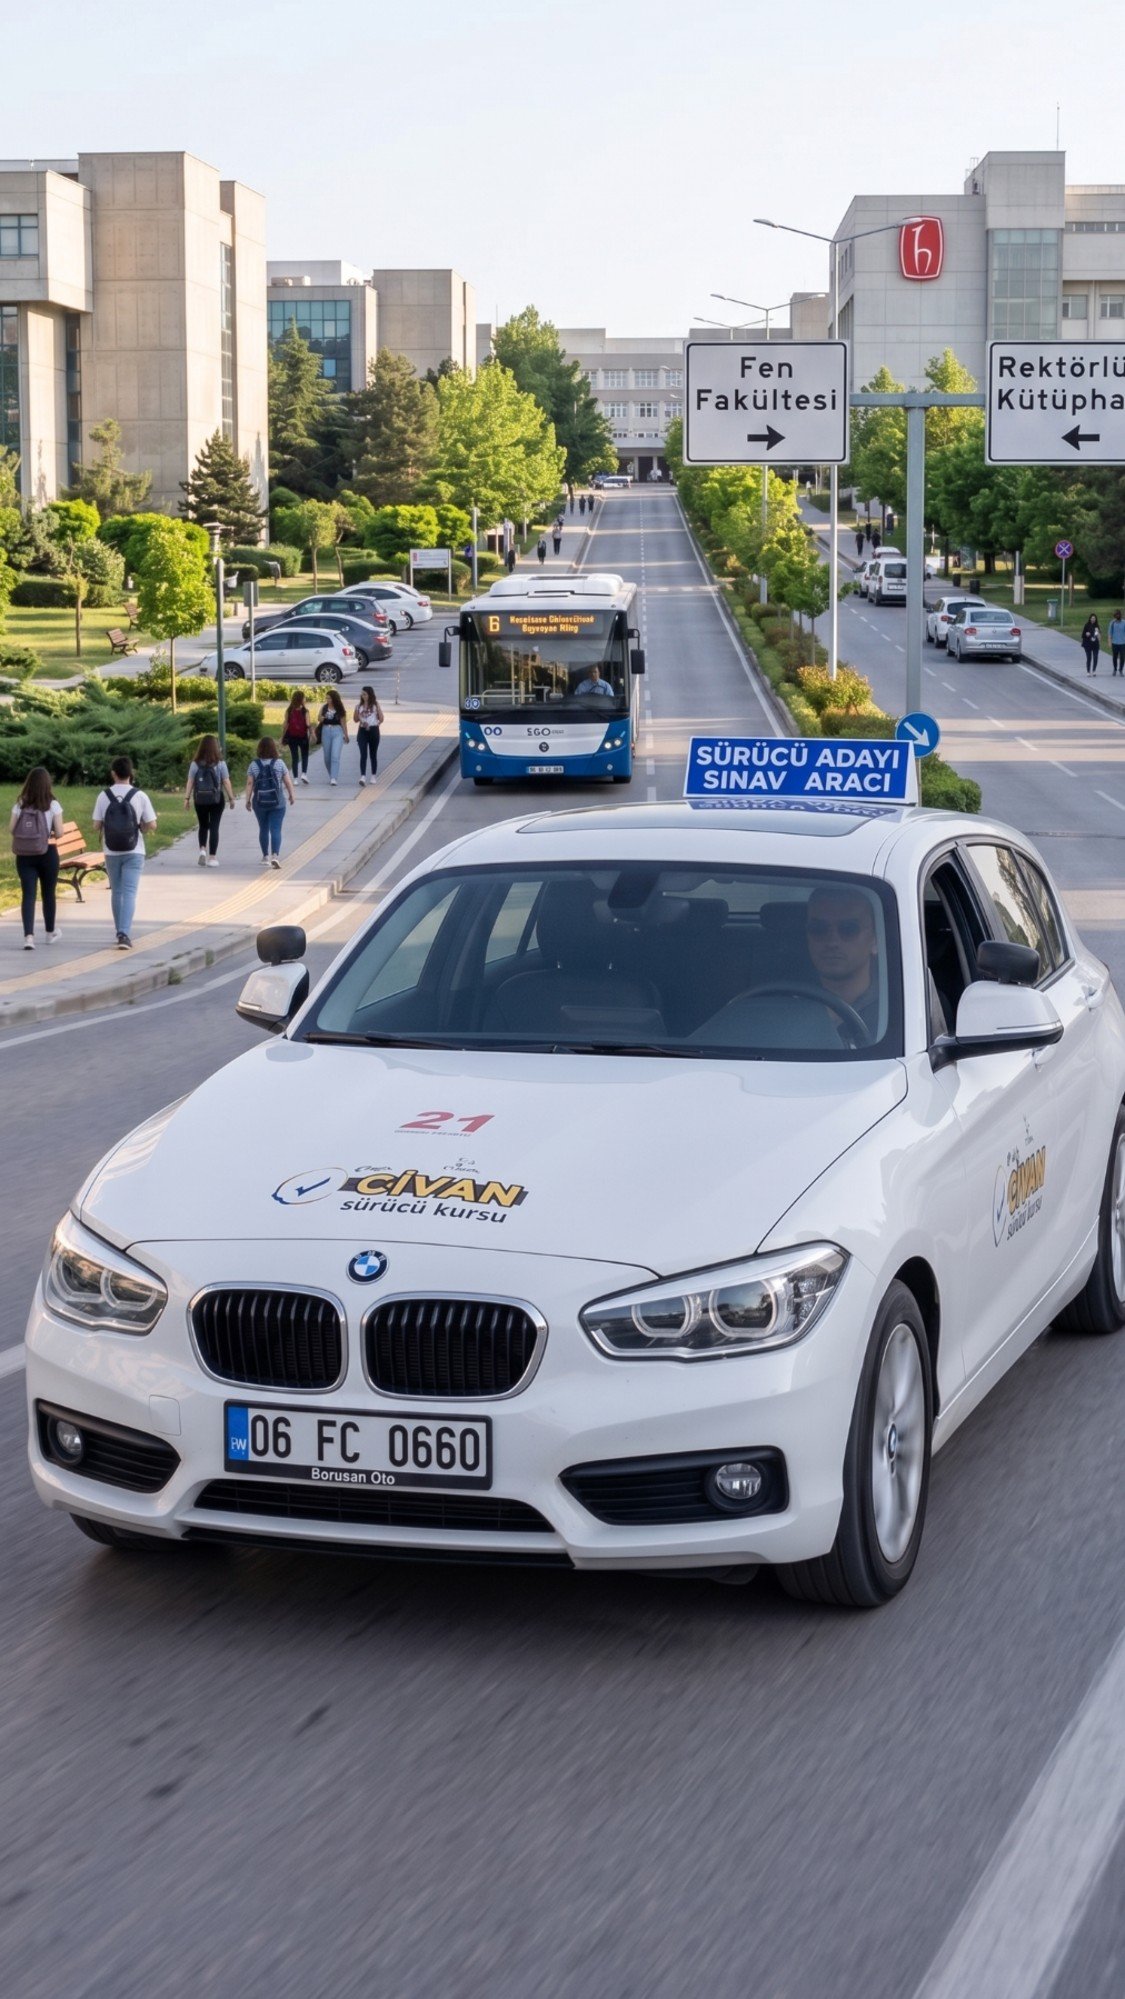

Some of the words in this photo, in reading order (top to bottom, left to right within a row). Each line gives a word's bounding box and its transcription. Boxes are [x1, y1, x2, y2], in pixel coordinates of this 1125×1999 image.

[740, 356, 794, 379] Fen
[999, 356, 1125, 378] Rektörlü
[696, 388, 837, 411] Fakültesi
[998, 388, 1125, 416] Kütüpha
[696, 741, 808, 767] SÜRÜCÜ
[815, 748, 900, 770] ADAYI
[703, 770, 787, 790] SINAV
[804, 772, 890, 792] ARACI
[399, 1111, 495, 1133] 21
[340, 1197, 427, 1214] sürücü
[433, 1202, 507, 1223] kursu
[251, 1414, 291, 1458] 06
[317, 1419, 360, 1463] FC
[389, 1424, 480, 1471] 0660
[311, 1467, 366, 1484] Borusan
[371, 1471, 396, 1486] Oto
